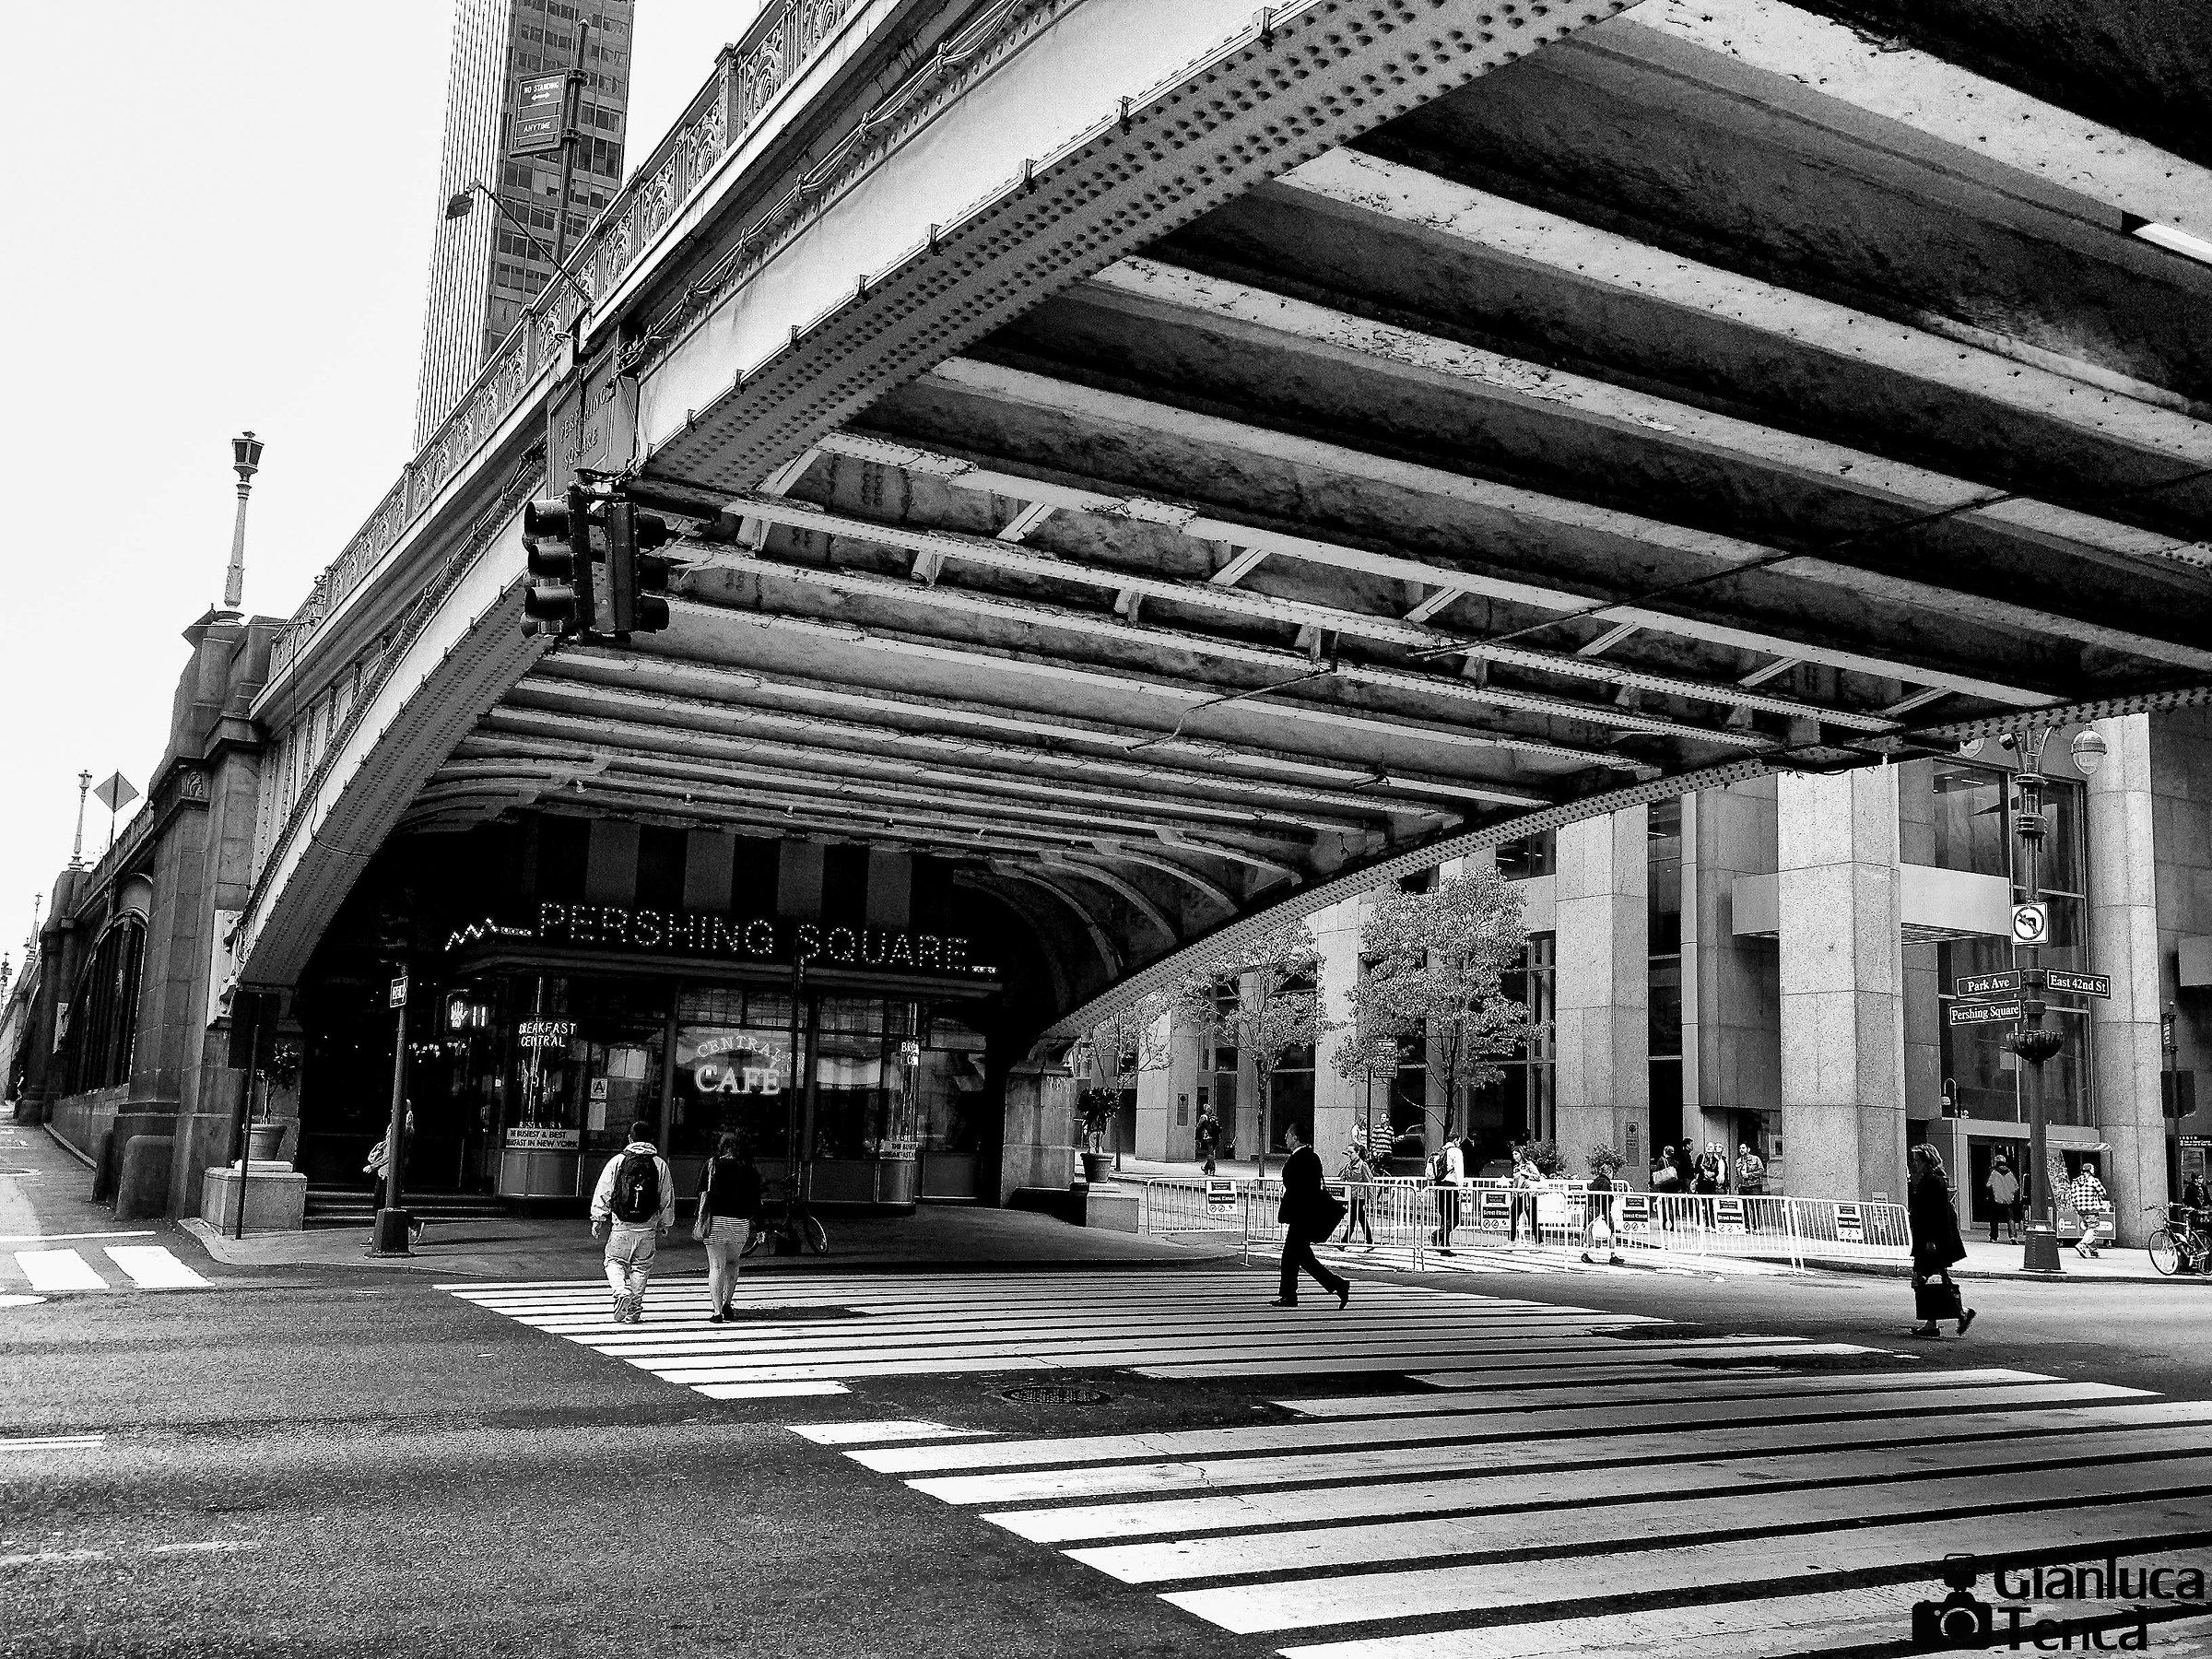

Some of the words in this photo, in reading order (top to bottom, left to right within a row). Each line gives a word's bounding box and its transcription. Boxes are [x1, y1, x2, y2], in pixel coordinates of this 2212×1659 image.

[524, 86, 533, 94] NO
[534, 82, 559, 92] STANDING
[523, 121, 551, 133] ANYTIME
[538, 901, 773, 956] PERSHING
[798, 924, 968, 971] SQUARE
[1967, 979, 1990, 993] Park
[1992, 977, 2010, 989] Ave
[2050, 974, 2071, 987] East
[2072, 978, 2094, 991] 42nd
[2096, 981, 2106, 993] St
[1951, 1007, 1988, 1020] Pershing
[1990, 1006, 2019, 1018] Square
[518, 1022, 577, 1034] BREAKFAST
[520, 1035, 566, 1047] CENTRAL
[698, 1035, 782, 1068] CENTRAL
[593, 1080, 605, 1094] A
[695, 1065, 782, 1096] CAFE
[536, 1139, 556, 1147] NEW
[555, 1140, 578, 1148] YORK
